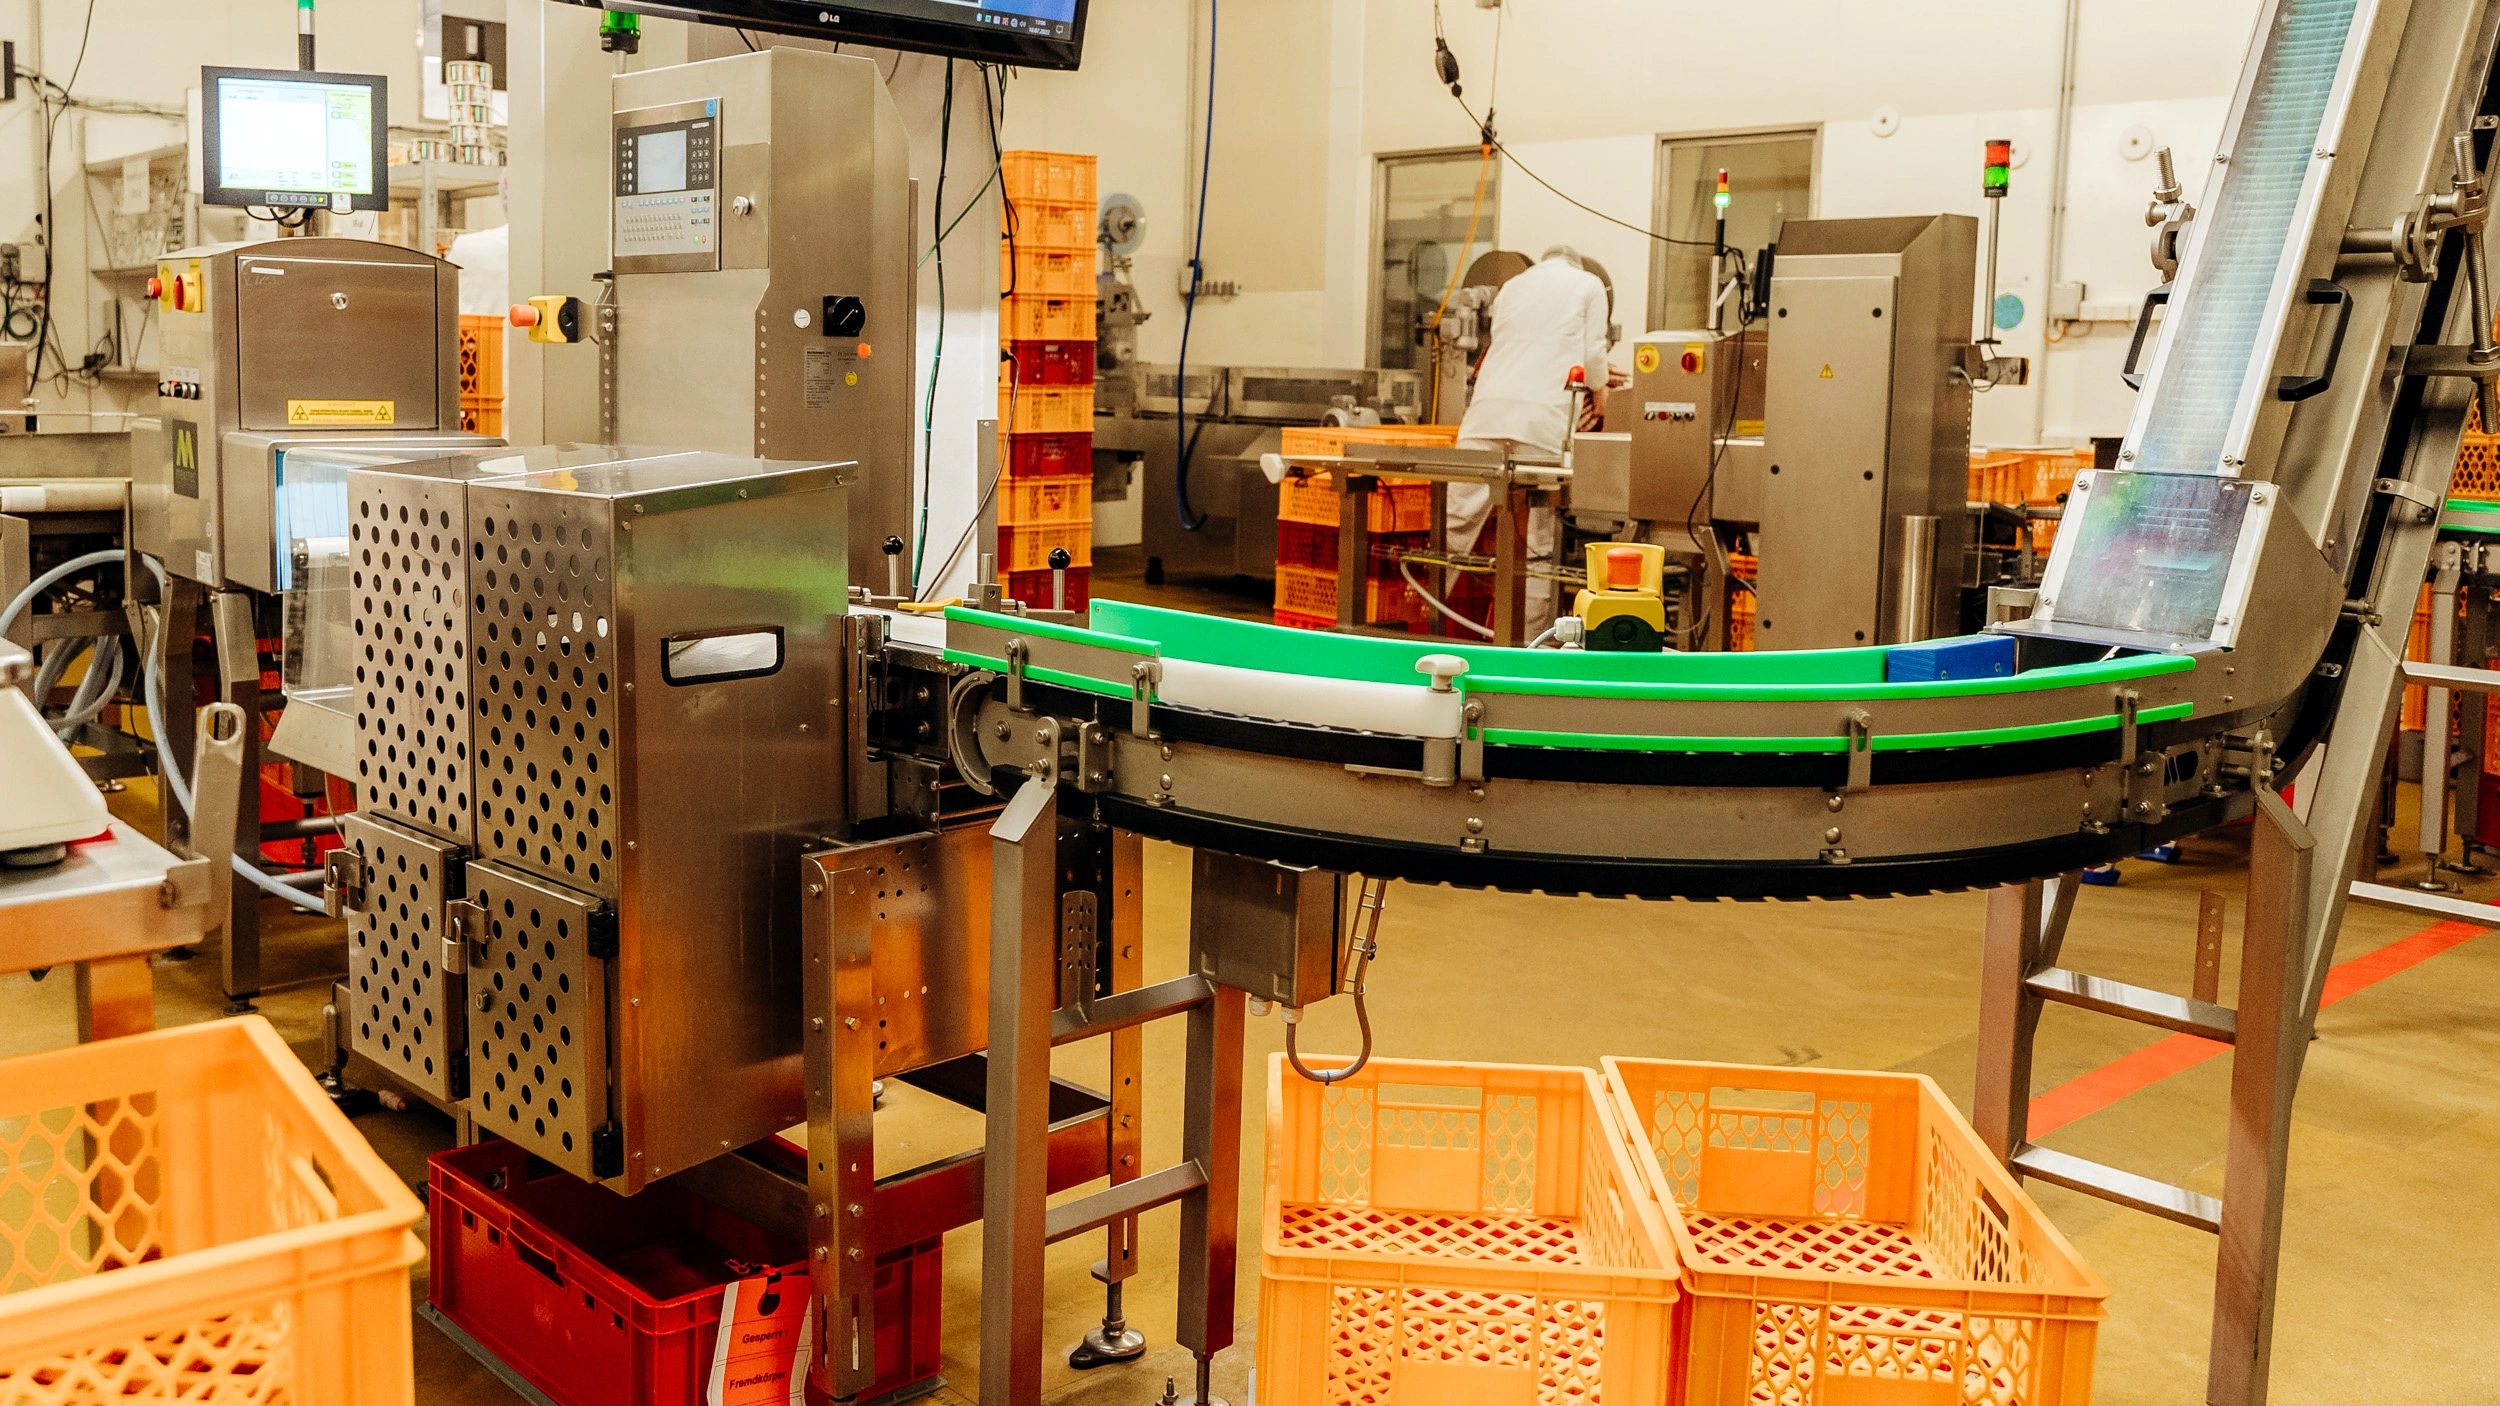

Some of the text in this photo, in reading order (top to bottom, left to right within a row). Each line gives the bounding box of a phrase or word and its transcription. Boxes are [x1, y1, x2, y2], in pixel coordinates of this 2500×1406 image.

[829, 14, 840, 23] LG
[742, 1330, 783, 1344] Gesperrt
[729, 1371, 787, 1390] Fremdkörper
